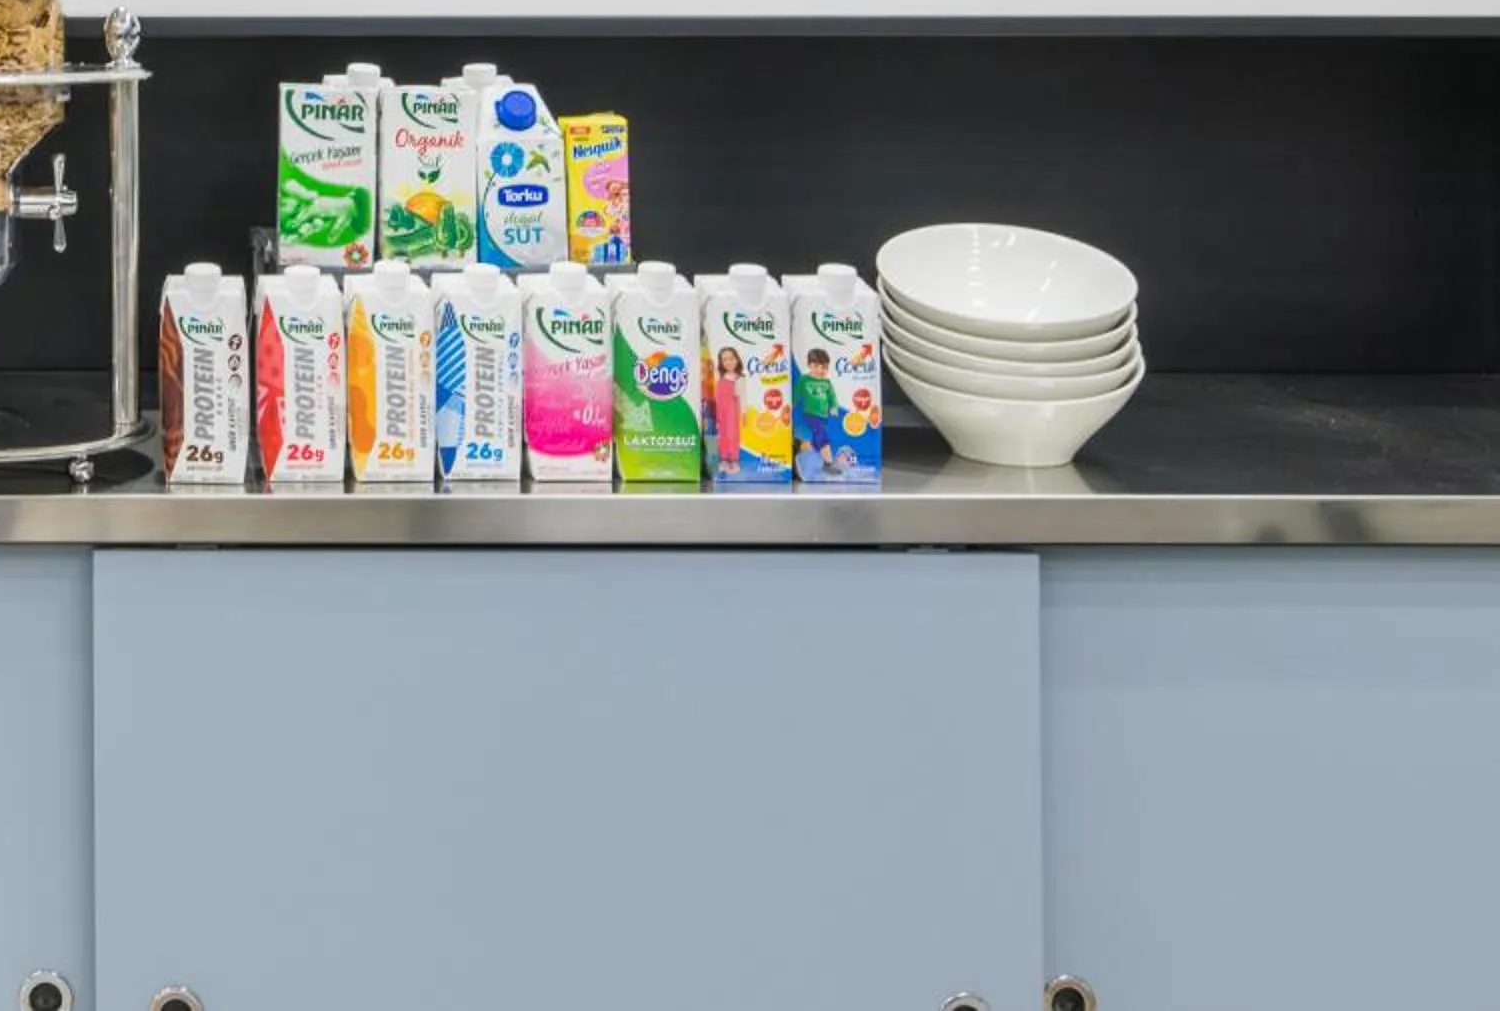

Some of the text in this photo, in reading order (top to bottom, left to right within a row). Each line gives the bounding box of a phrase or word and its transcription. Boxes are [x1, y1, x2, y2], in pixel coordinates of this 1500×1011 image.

[302, 102, 364, 121] PINAR
[413, 100, 457, 114] PINAR
[395, 128, 464, 157] Organik
[573, 136, 621, 158] Nesquik
[503, 188, 543, 202] Torku
[551, 317, 603, 334] PINAR
[733, 319, 773, 331] PINAR
[822, 319, 863, 331] PINAR
